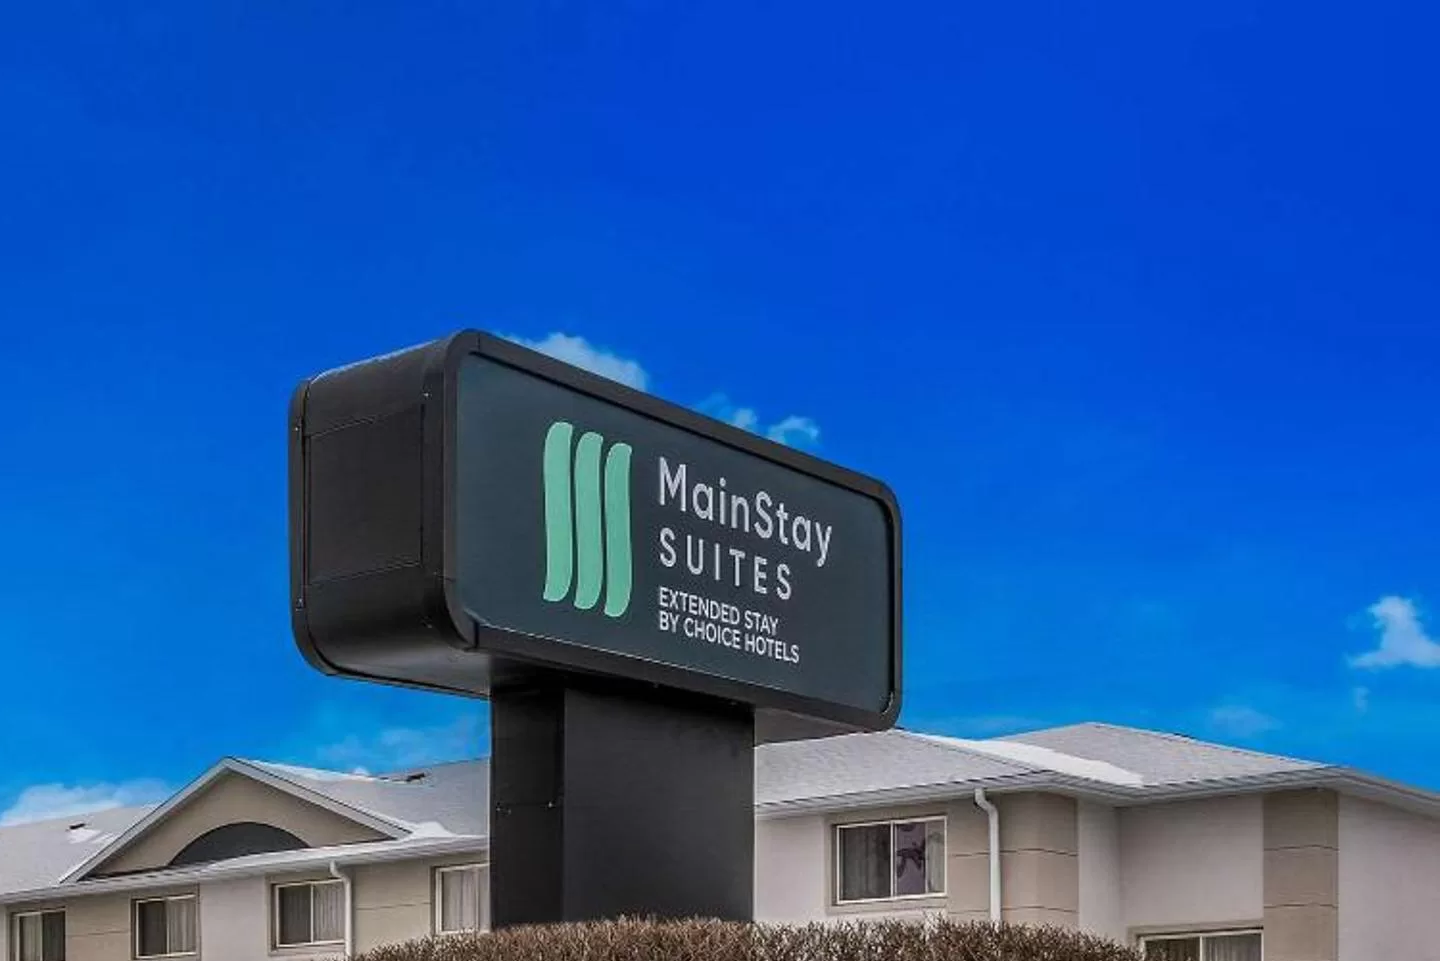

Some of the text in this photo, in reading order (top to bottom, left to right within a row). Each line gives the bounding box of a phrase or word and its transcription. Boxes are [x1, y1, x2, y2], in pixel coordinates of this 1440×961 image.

[659, 457, 832, 567] MainStay
[660, 527, 792, 600] SUITES
[660, 587, 779, 636] EXTENDED STAY
[660, 611, 799, 664] BY CHOICE HOTELS
